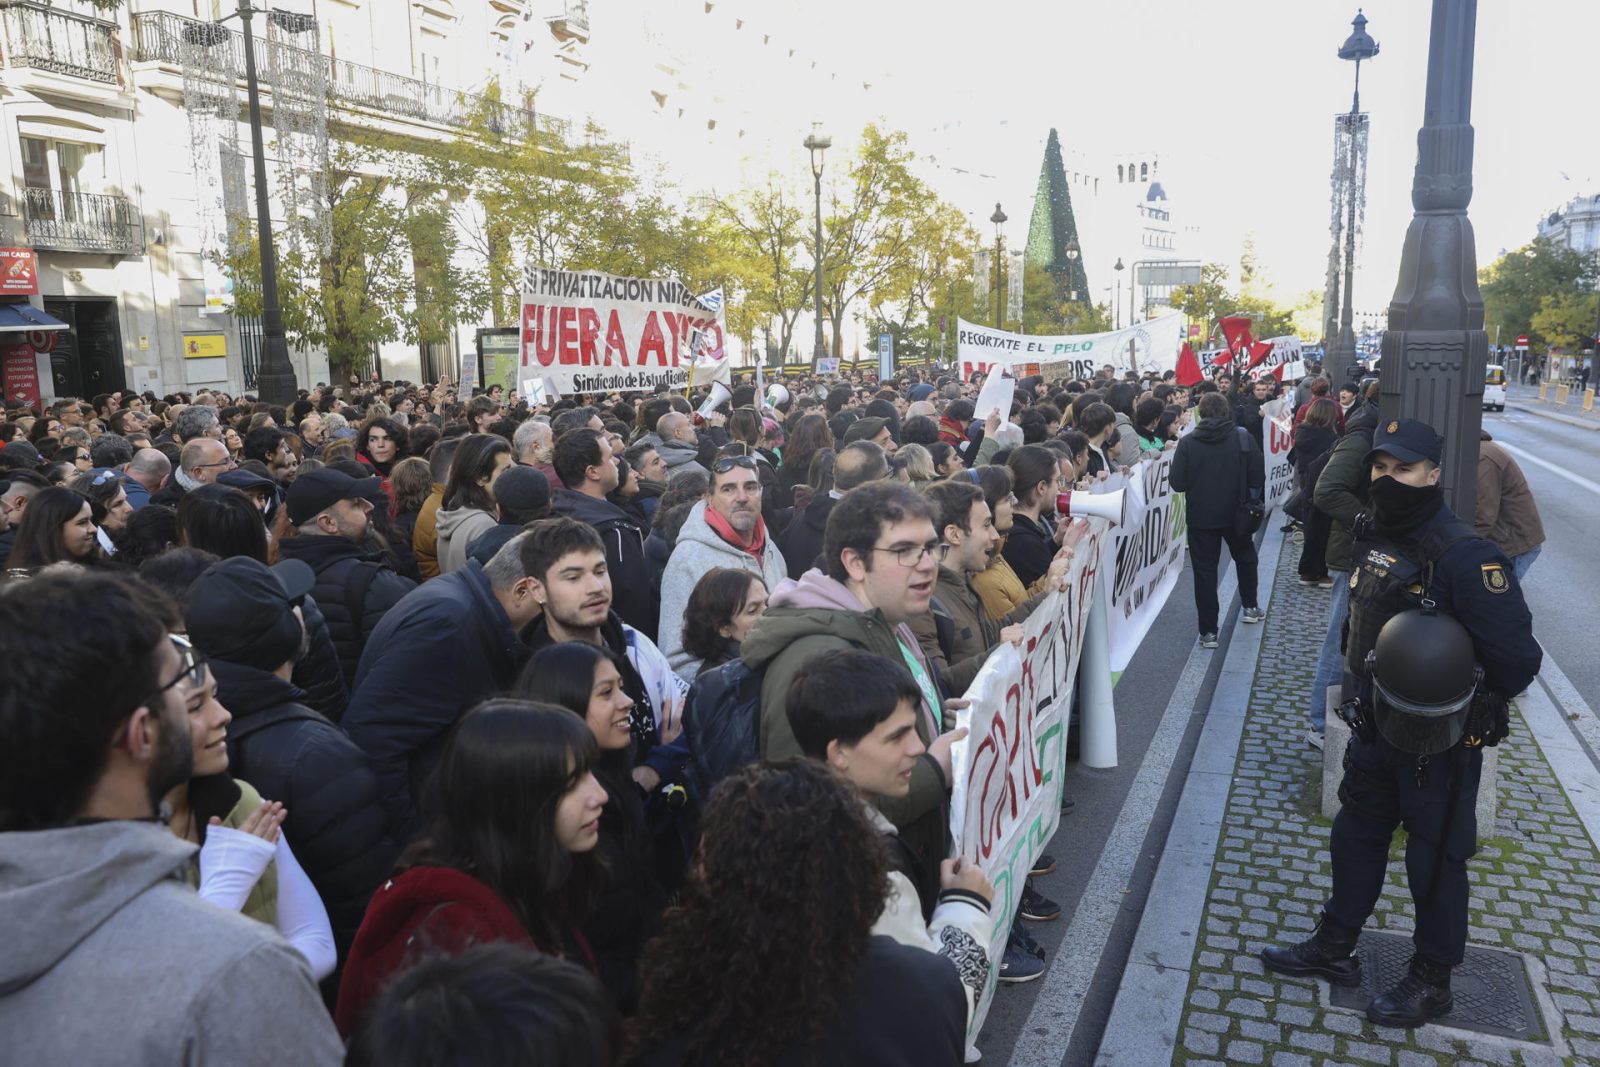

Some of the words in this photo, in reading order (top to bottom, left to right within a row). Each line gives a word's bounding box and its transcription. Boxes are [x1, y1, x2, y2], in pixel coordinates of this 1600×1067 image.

[69, 270, 82, 281] 35
[521, 303, 630, 367] FUERA
[637, 310, 724, 367] AYO
[1027, 342, 1046, 352] EL
[1052, 340, 1094, 355] PELO
[573, 371, 624, 393] Sindicato
[625, 371, 638, 388] de
[1270, 463, 1293, 481] FREN
